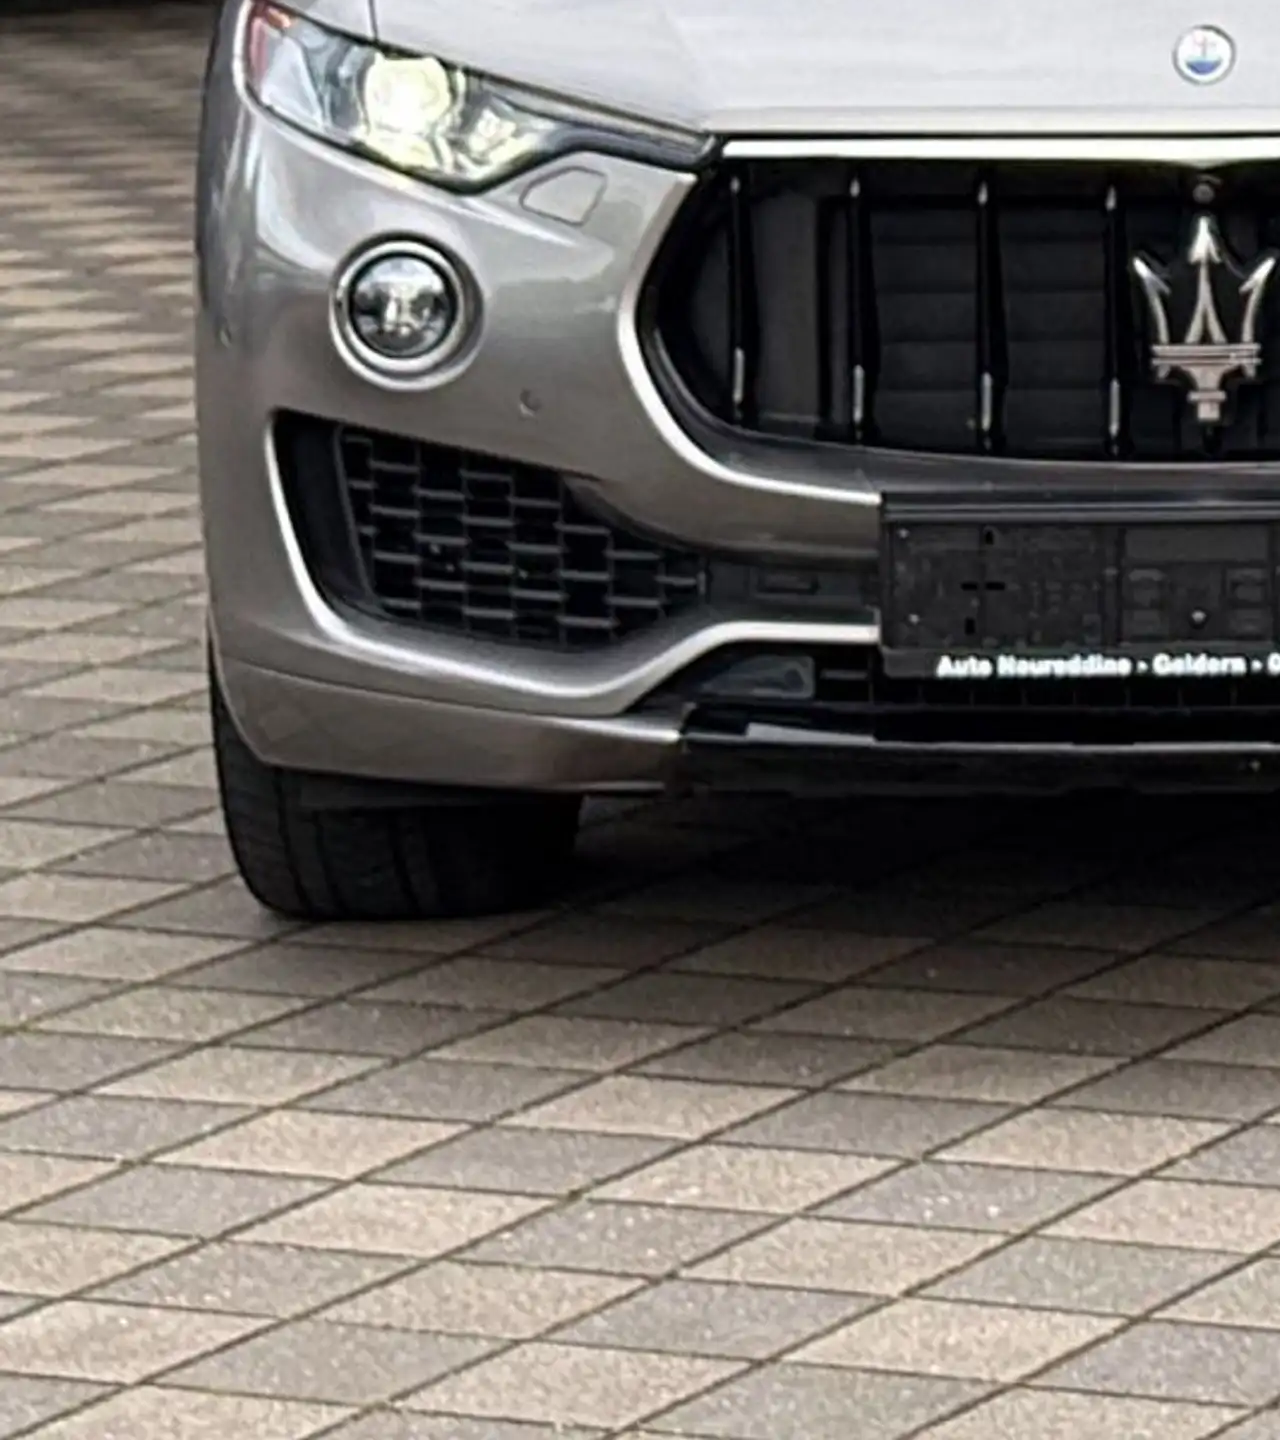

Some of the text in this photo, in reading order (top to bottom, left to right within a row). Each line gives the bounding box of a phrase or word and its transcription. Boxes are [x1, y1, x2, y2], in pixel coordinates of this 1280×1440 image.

[936, 655, 993, 677] Auto
[997, 654, 1132, 677] Noureddine
[1152, 653, 1247, 676] Geldern
